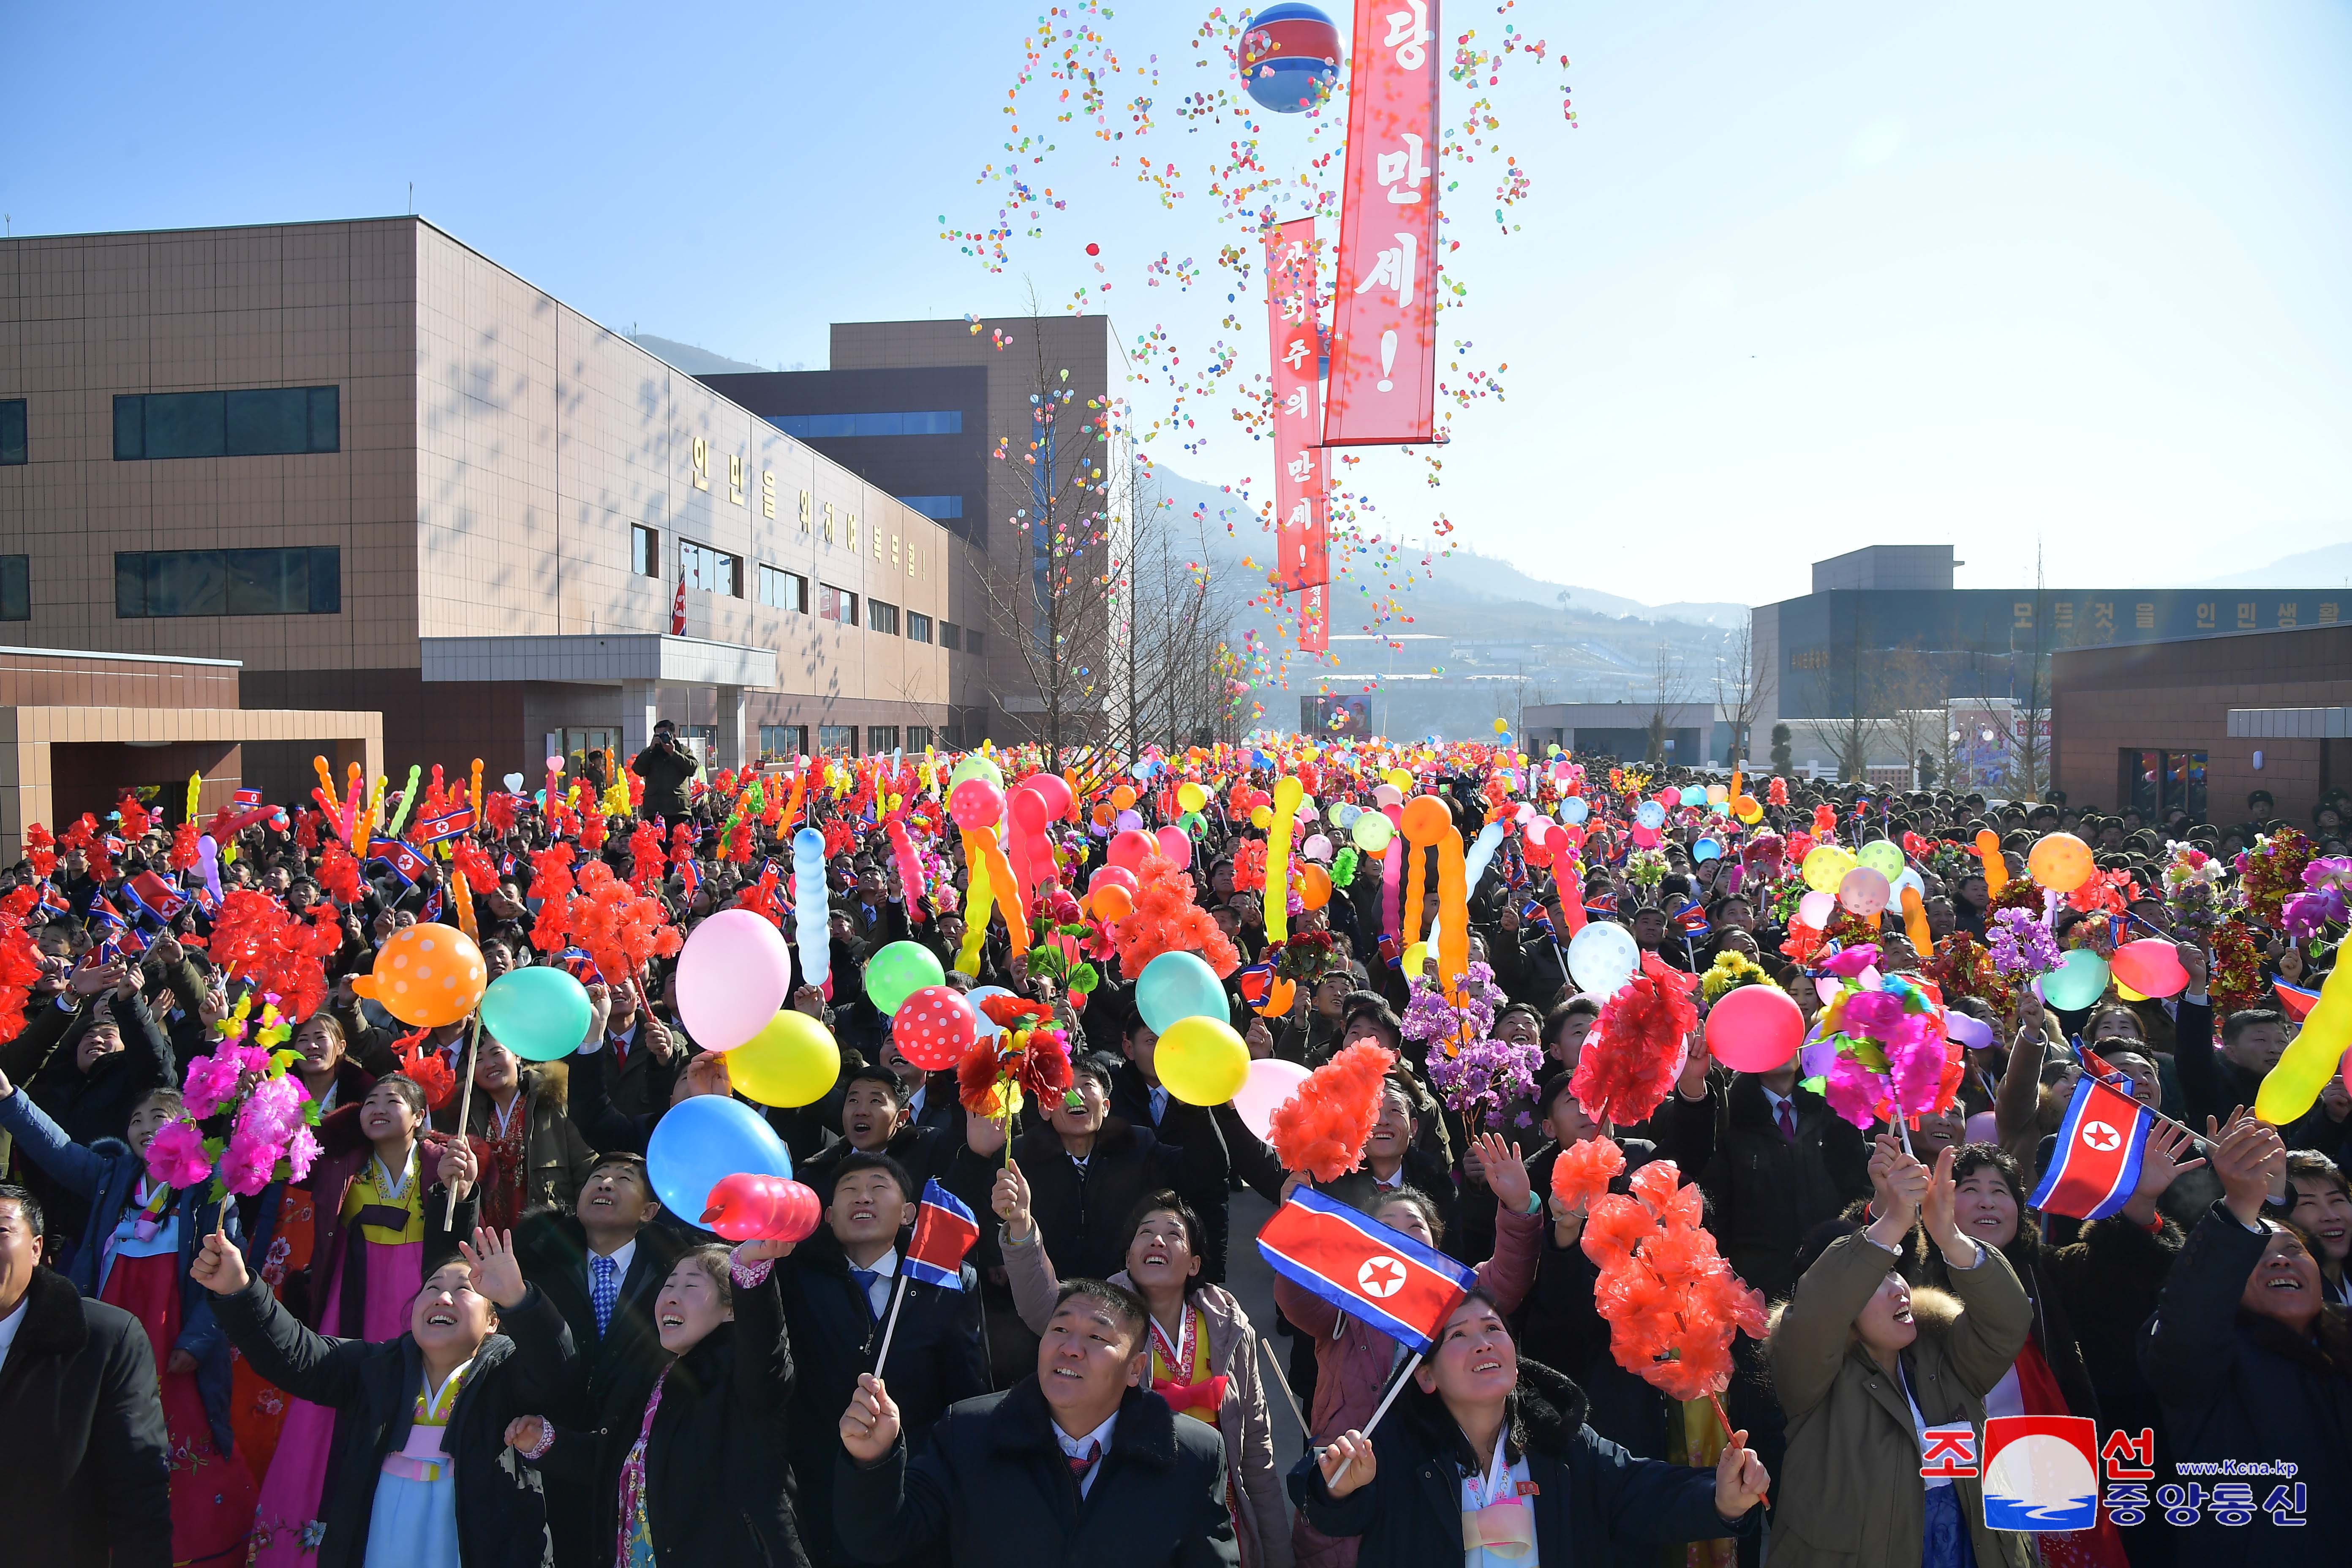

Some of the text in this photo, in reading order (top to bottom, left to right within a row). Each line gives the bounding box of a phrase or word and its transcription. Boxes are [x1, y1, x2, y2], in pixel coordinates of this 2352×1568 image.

[1354, 0, 1435, 392] 당 만세!
[693, 436, 926, 581] 인민을 위하여 복무함!
[1286, 451, 1315, 568] 만세!
